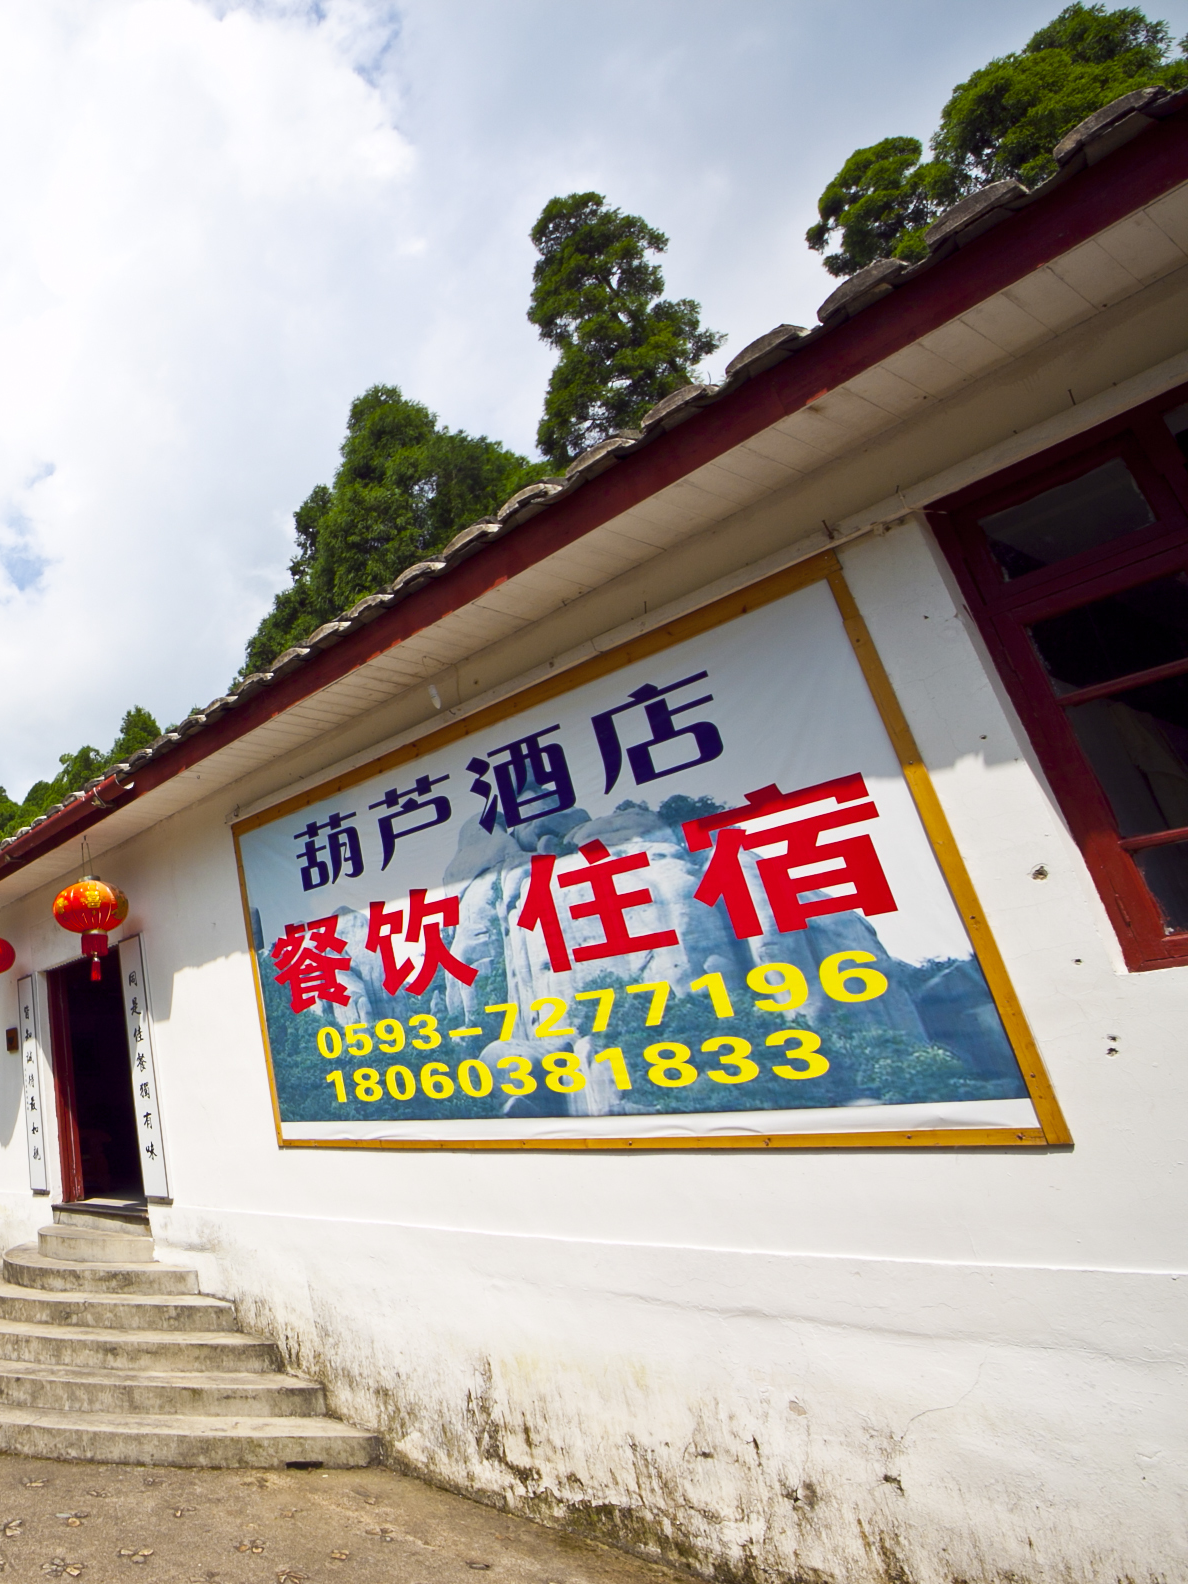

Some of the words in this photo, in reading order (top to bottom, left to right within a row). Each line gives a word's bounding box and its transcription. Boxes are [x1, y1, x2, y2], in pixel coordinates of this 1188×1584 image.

[293, 669, 724, 892] 葫芦酒店
[270, 771, 899, 1016] 餐饮住宿
[316, 950, 889, 1060] 0593-7277196
[325, 1029, 832, 1105] 18060381833
